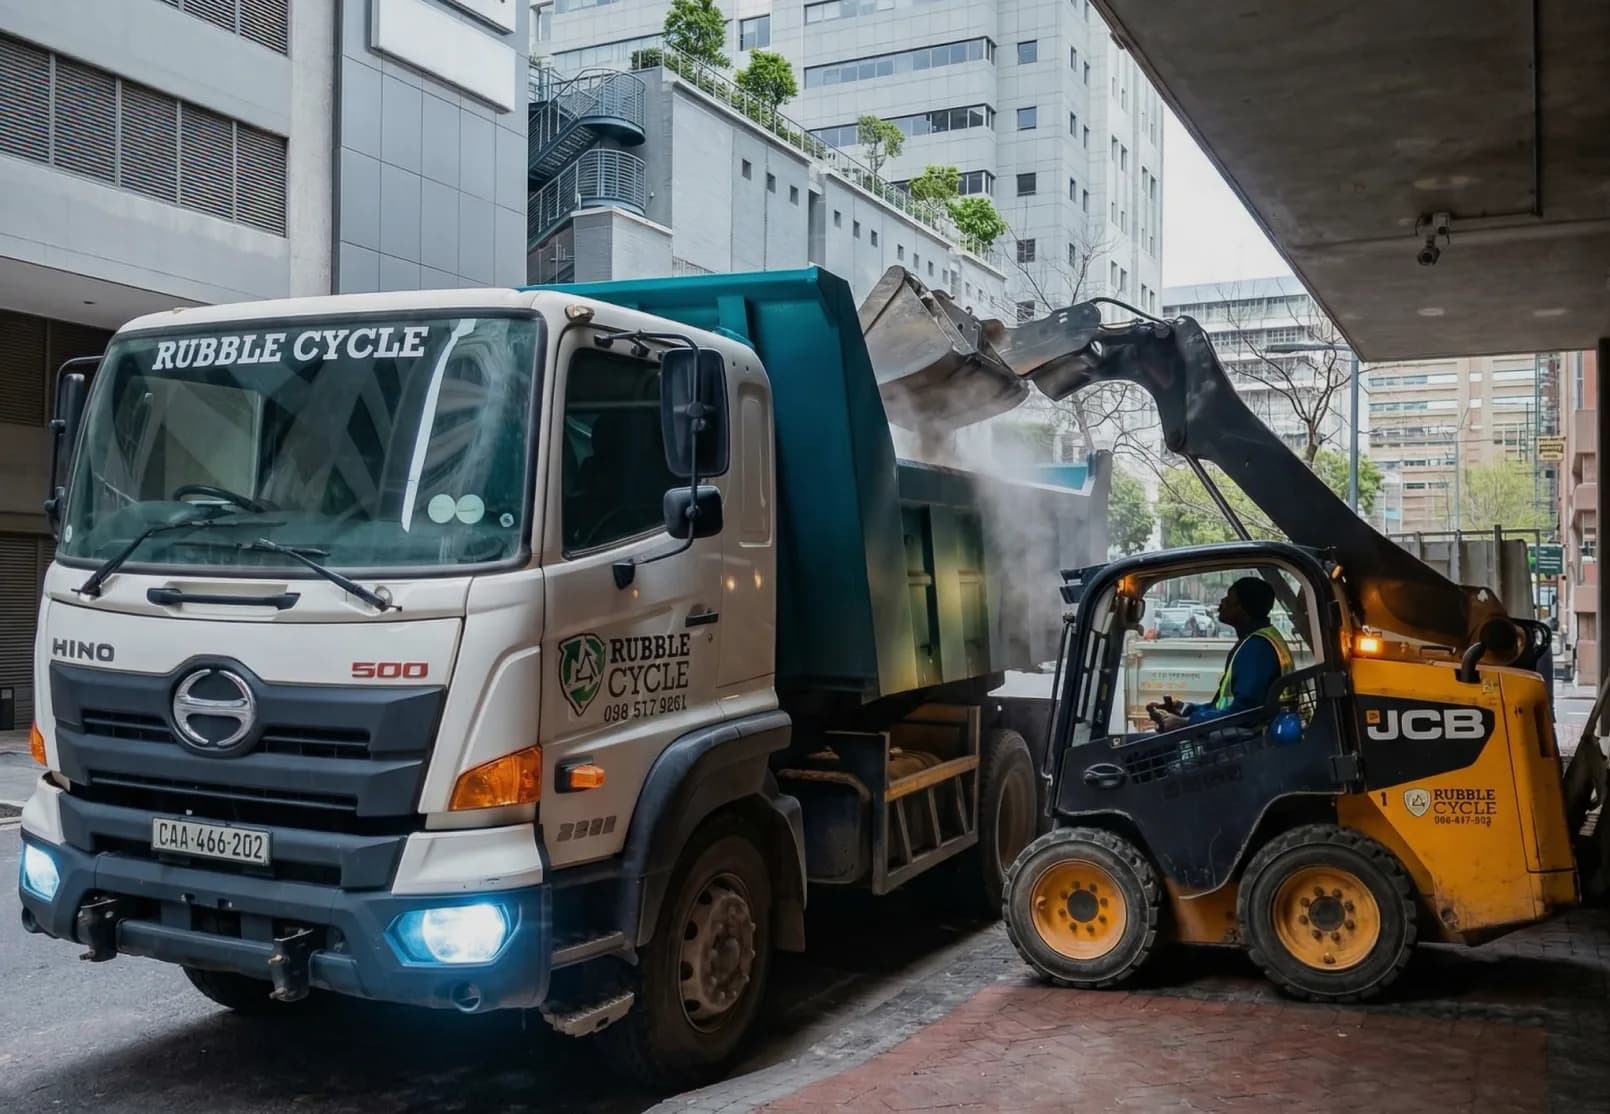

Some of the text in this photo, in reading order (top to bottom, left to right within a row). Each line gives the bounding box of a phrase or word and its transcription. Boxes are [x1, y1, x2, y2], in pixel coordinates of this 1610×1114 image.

[152, 326, 429, 370] RUBBLE CYCLE
[52, 637, 115, 662] HINO
[609, 633, 690, 664] RUBBLE
[352, 662, 428, 678] 500
[608, 661, 689, 698] CYCLE
[633, 699, 657, 718] 517
[659, 694, 687, 714] 9261
[1367, 709, 1485, 740] JCB
[1433, 789, 1496, 801] RUBBLE
[1433, 801, 1497, 815] CYCLE
